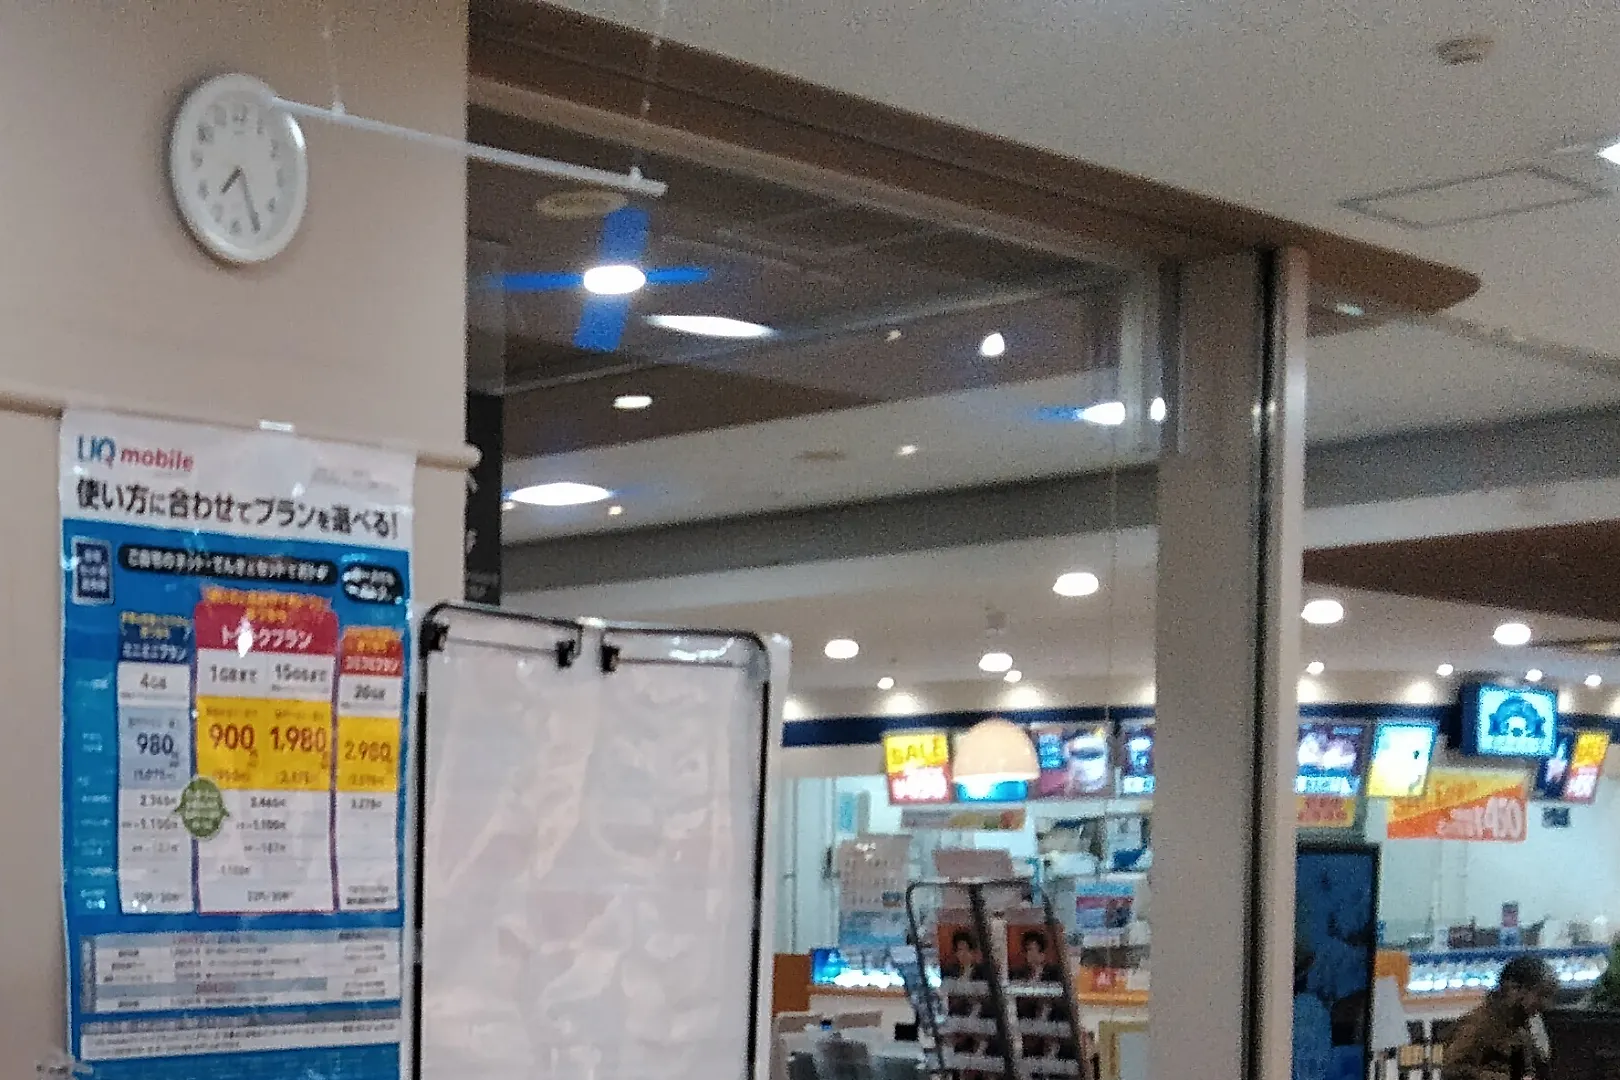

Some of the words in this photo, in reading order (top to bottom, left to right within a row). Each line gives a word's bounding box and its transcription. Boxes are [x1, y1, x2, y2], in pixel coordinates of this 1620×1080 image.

[77, 436, 116, 468] UQ
[120, 445, 194, 472] mobile
[136, 731, 175, 756] 980
[209, 722, 256, 751] 900
